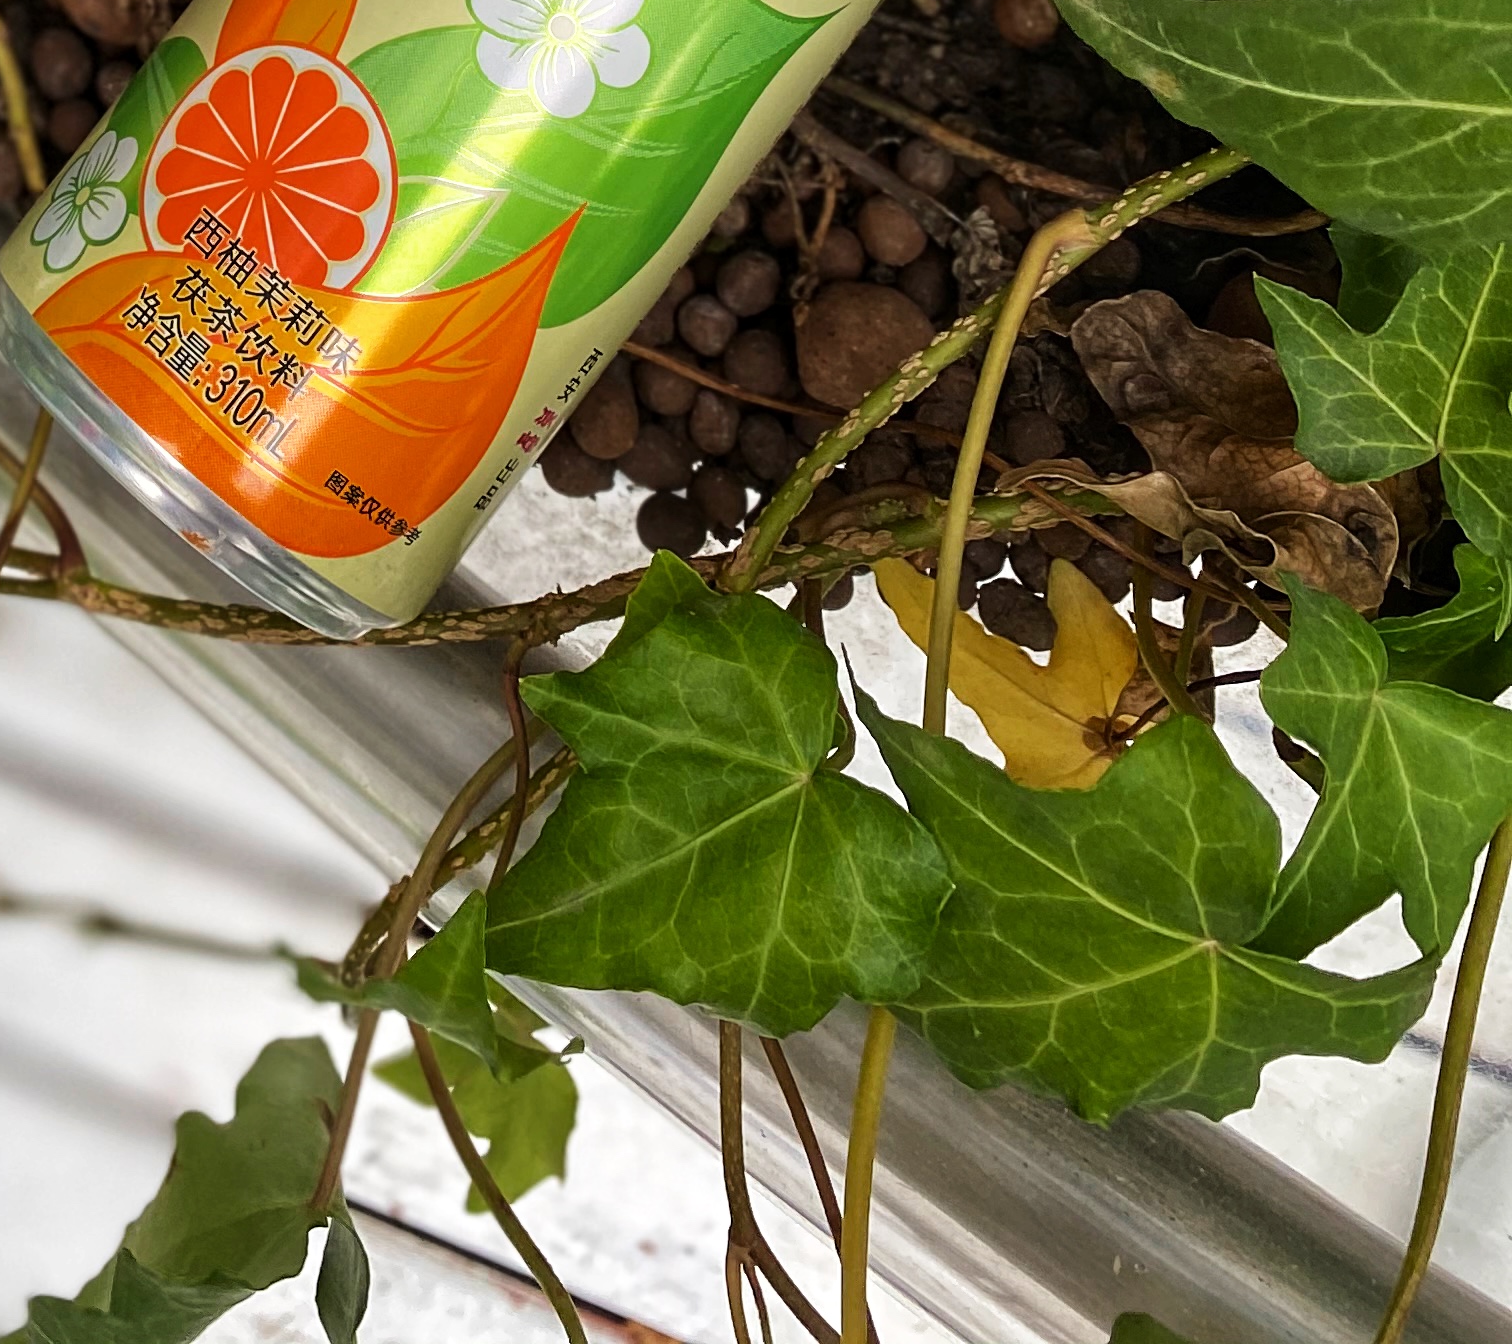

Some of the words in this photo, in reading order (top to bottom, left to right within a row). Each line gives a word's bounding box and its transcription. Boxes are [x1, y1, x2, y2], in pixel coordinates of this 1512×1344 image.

[171, 265, 315, 402] 茯茶饮料
[184, 207, 364, 378] 西柚茉莉味
[324, 469, 424, 546] 图案仅供参考
